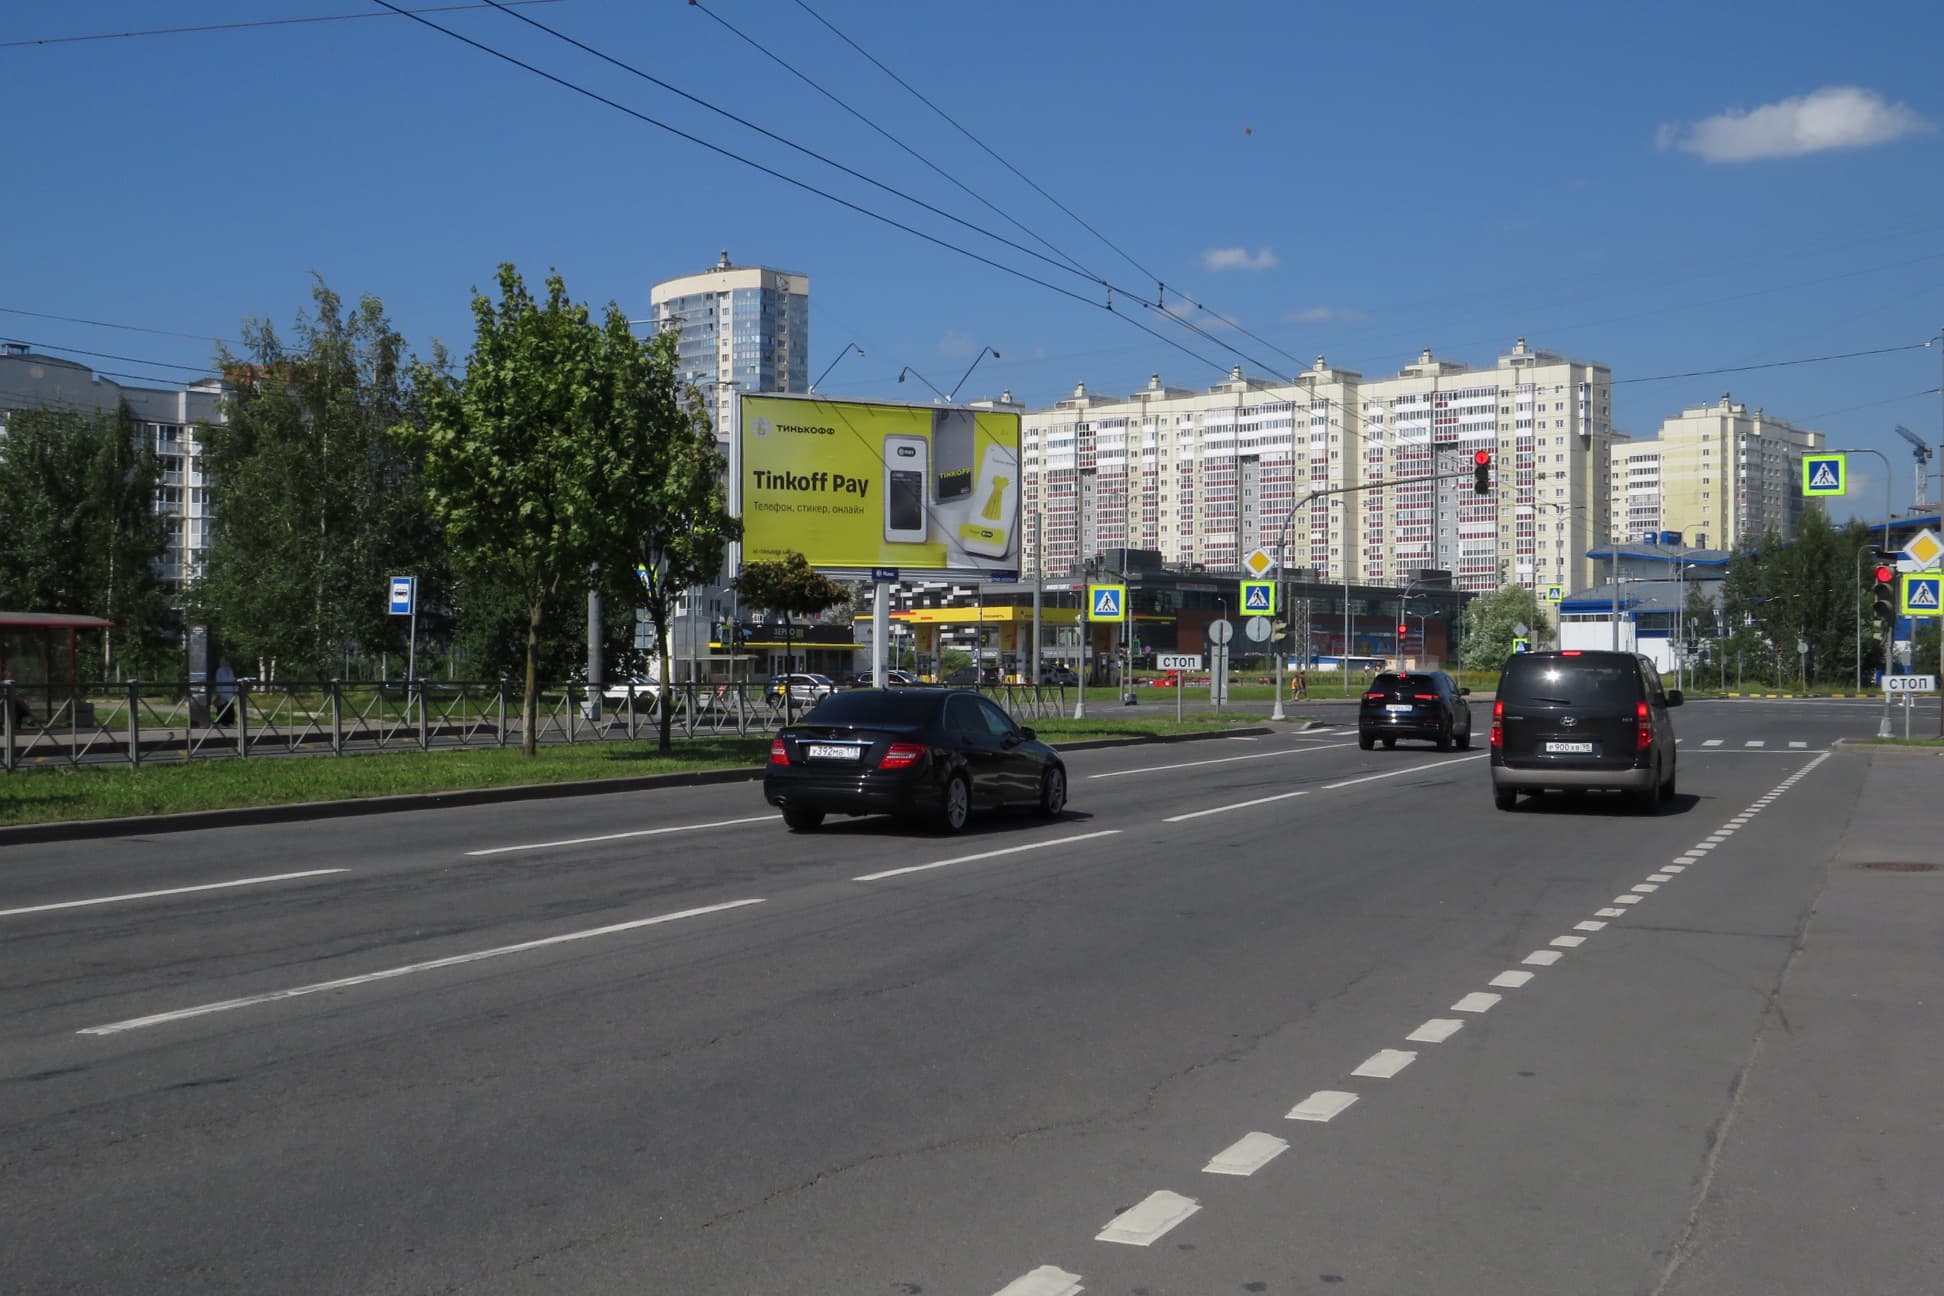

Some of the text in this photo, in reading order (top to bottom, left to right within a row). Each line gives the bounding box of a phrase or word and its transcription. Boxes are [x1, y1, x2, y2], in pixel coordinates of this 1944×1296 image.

[776, 424, 836, 435] ТИНЬКОФФ
[753, 470, 869, 498] Tinkoff Pay
[753, 501, 864, 515] Телефон, стикер, онлайн
[1163, 657, 1196, 668] СТОП
[1889, 678, 1928, 689] СТОП
